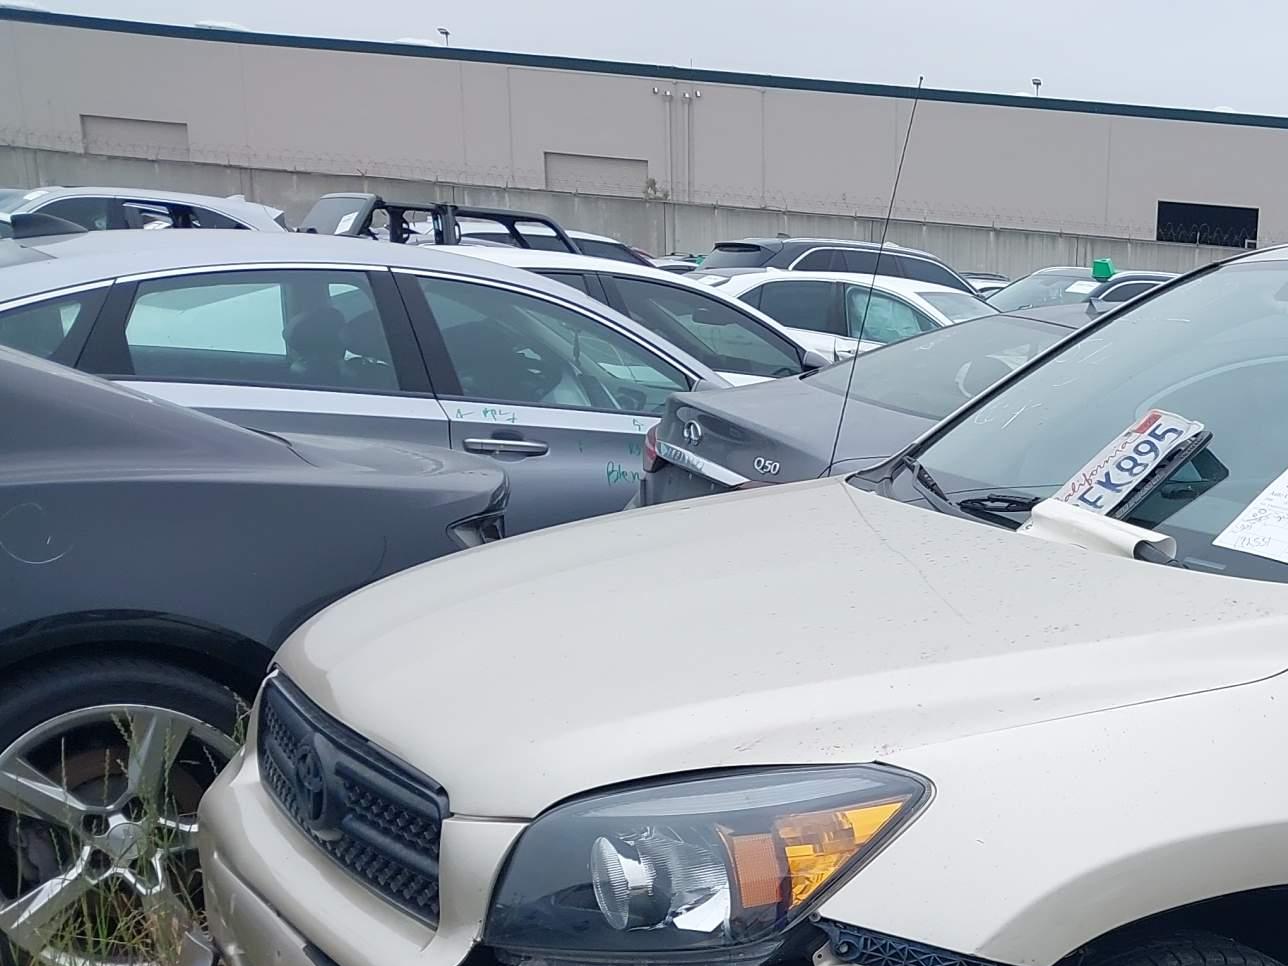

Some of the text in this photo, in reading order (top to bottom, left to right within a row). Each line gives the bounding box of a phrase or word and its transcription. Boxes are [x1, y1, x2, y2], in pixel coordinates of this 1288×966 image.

[753, 456, 780, 475] Q50
[1056, 436, 1139, 502] alifornia
[1072, 423, 1184, 509] FK895
